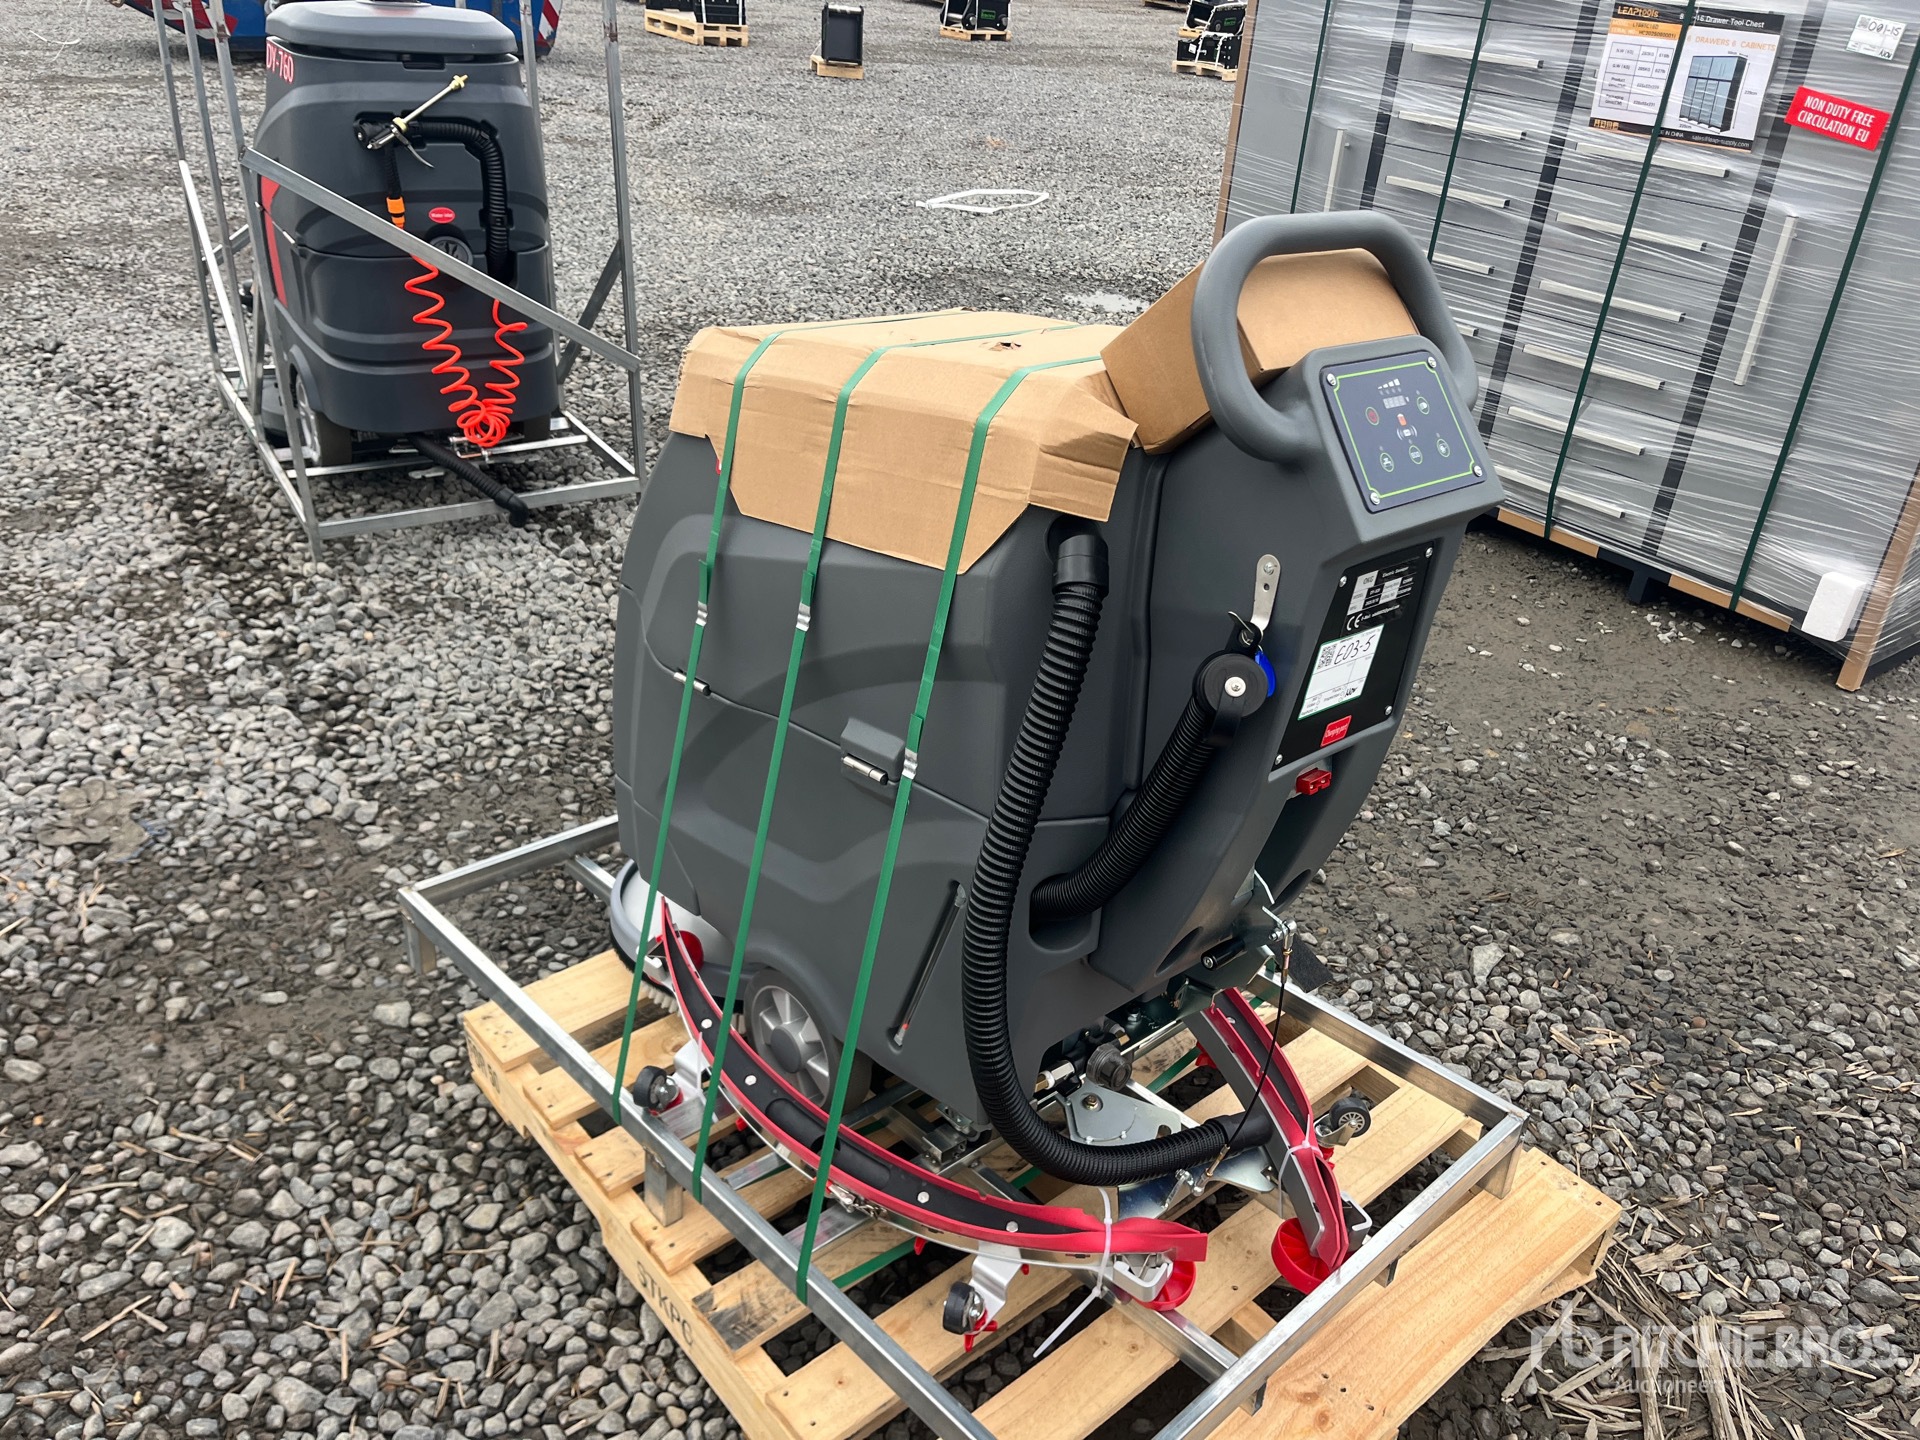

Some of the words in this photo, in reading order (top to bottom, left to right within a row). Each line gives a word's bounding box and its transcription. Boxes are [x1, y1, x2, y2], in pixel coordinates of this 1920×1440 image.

[1705, 15, 1728, 24] Drawer
[1730, 18, 1744, 26] Tool
[1745, 20, 1765, 28] Chest
[1695, 36, 1730, 47] DRAWERS
[1740, 41, 1777, 52] CABINETS
[1804, 95, 1826, 112] NON
[1825, 102, 1852, 120] DUTY
[1850, 110, 1875, 128] FREE
[1797, 110, 1855, 138] CIRCULATION
[1855, 128, 1870, 142] EU
